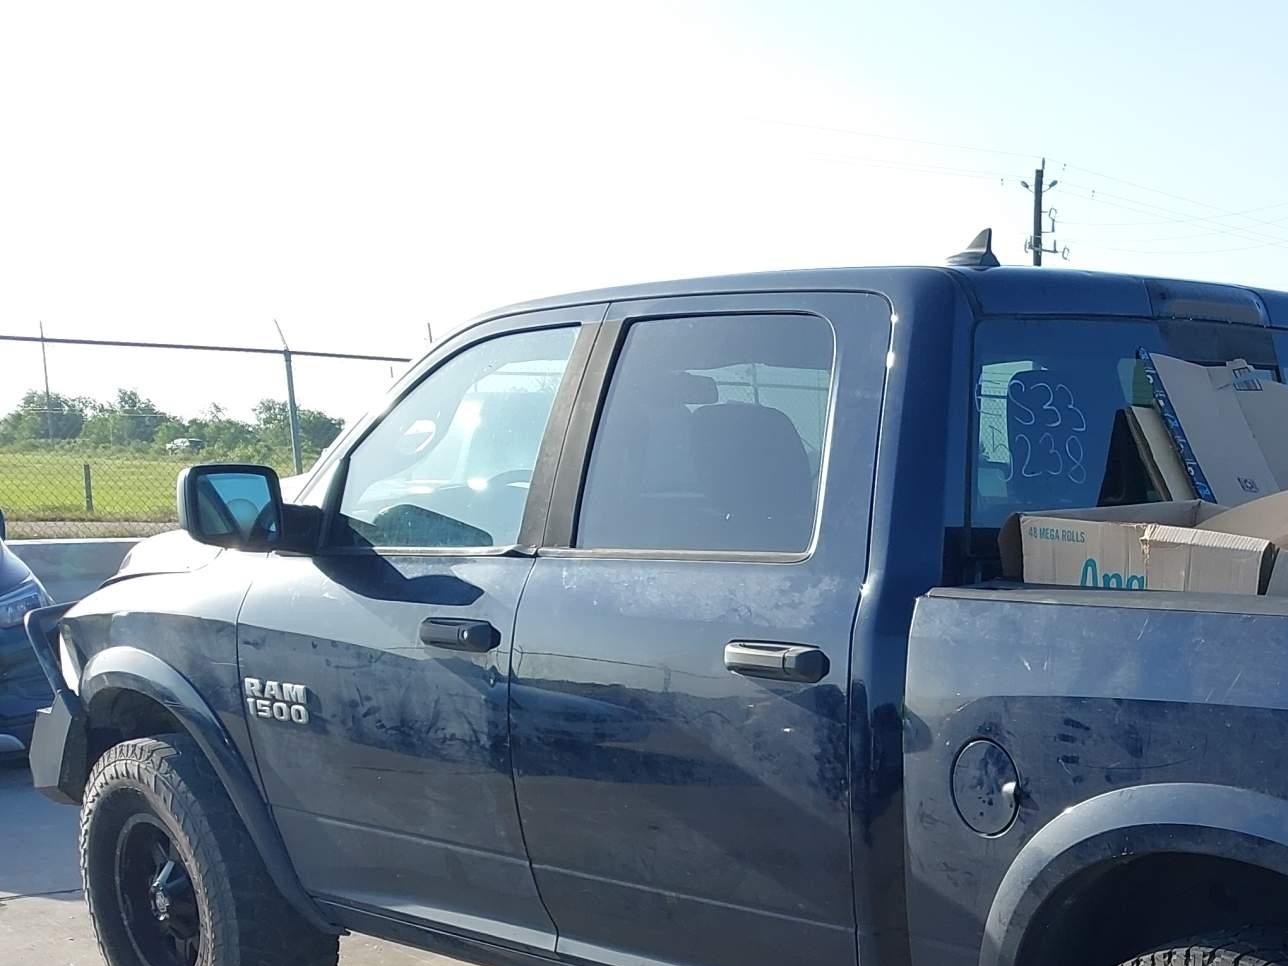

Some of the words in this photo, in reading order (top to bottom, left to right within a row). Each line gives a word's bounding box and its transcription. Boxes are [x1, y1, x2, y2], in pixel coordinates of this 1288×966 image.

[1028, 526, 1038, 538] 48
[1039, 527, 1060, 541] MEGA
[1061, 531, 1086, 543] ROLLS
[244, 677, 307, 704] RAM
[246, 697, 310, 724] 1500
